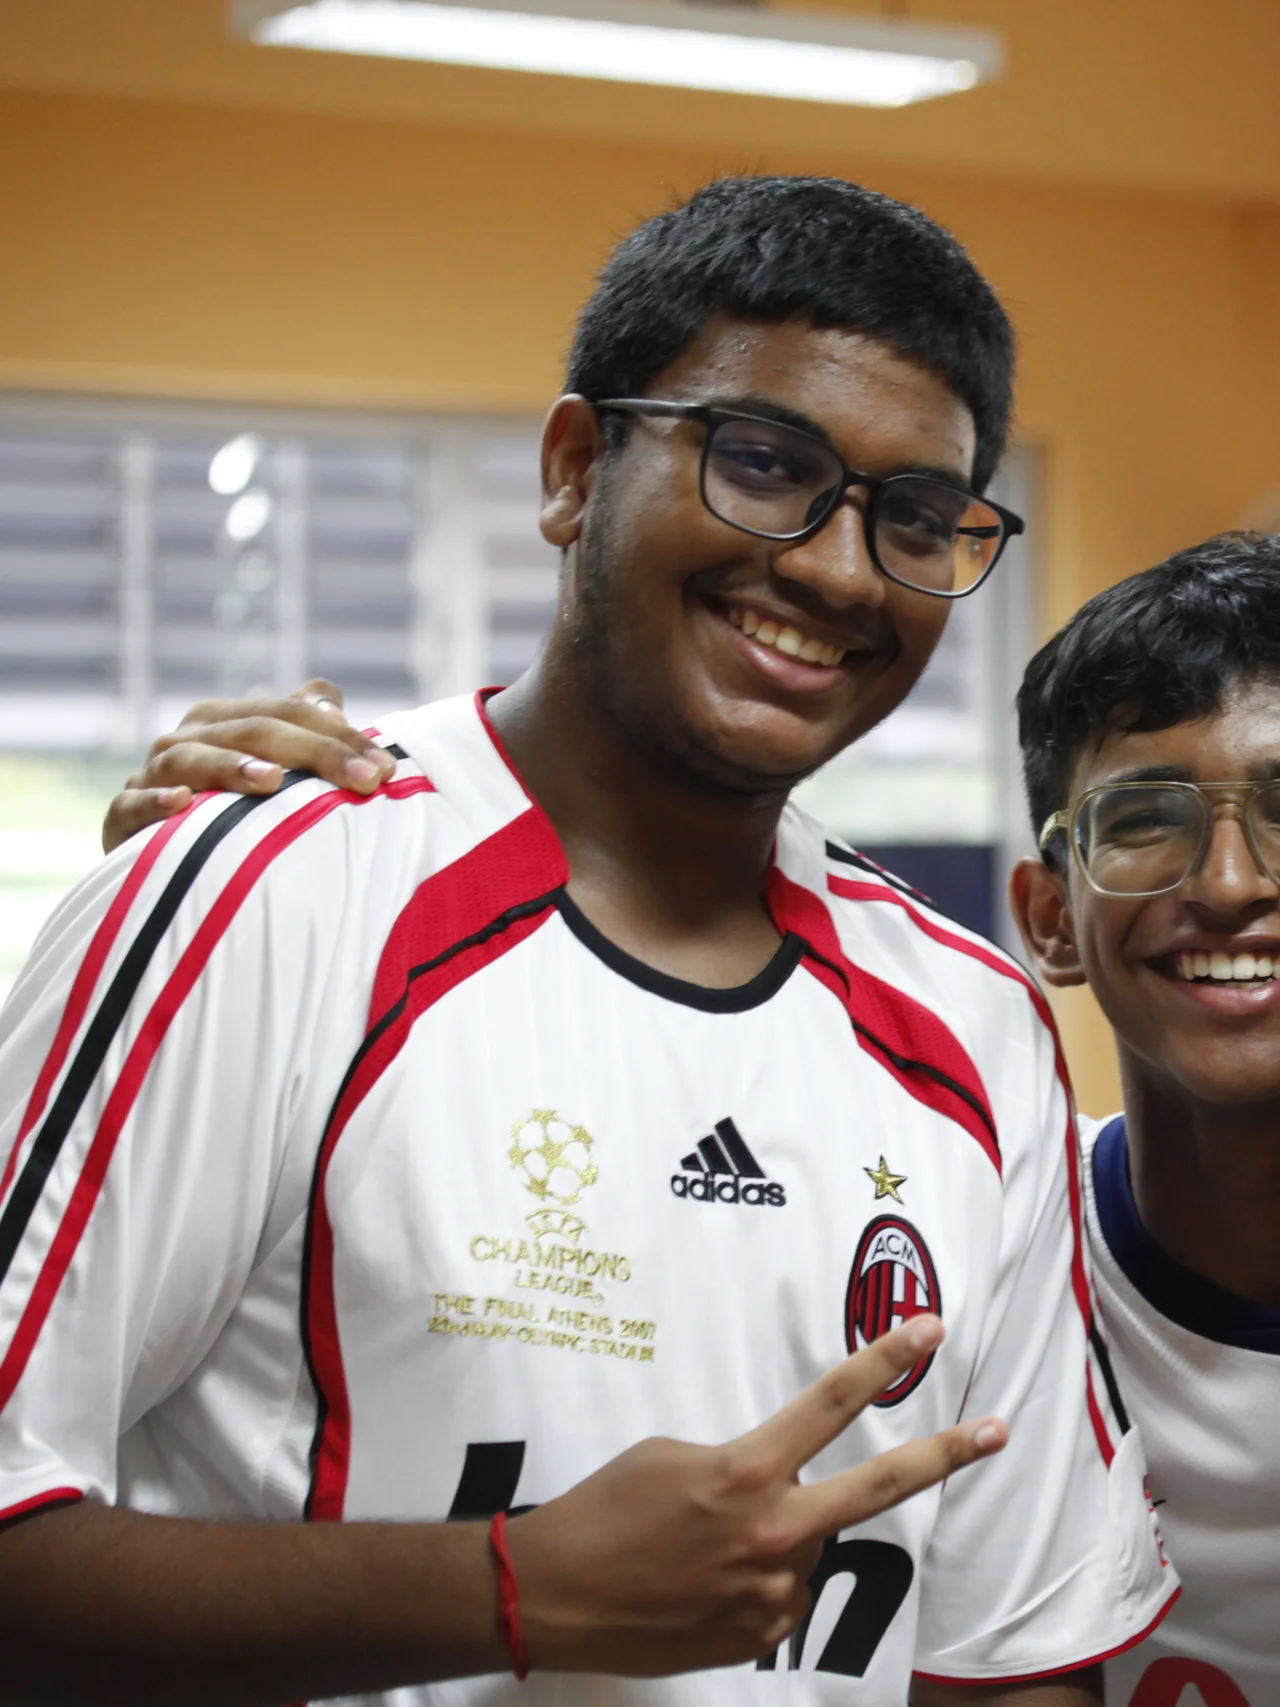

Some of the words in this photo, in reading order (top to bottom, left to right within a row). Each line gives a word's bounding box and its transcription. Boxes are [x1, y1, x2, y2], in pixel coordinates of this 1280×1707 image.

[671, 1171, 787, 1207] adidas
[470, 1235, 632, 1282] CHAMPIONS
[871, 1234, 917, 1270] ACM
[515, 1269, 595, 1299] LEAGUE
[433, 1292, 476, 1315] THE
